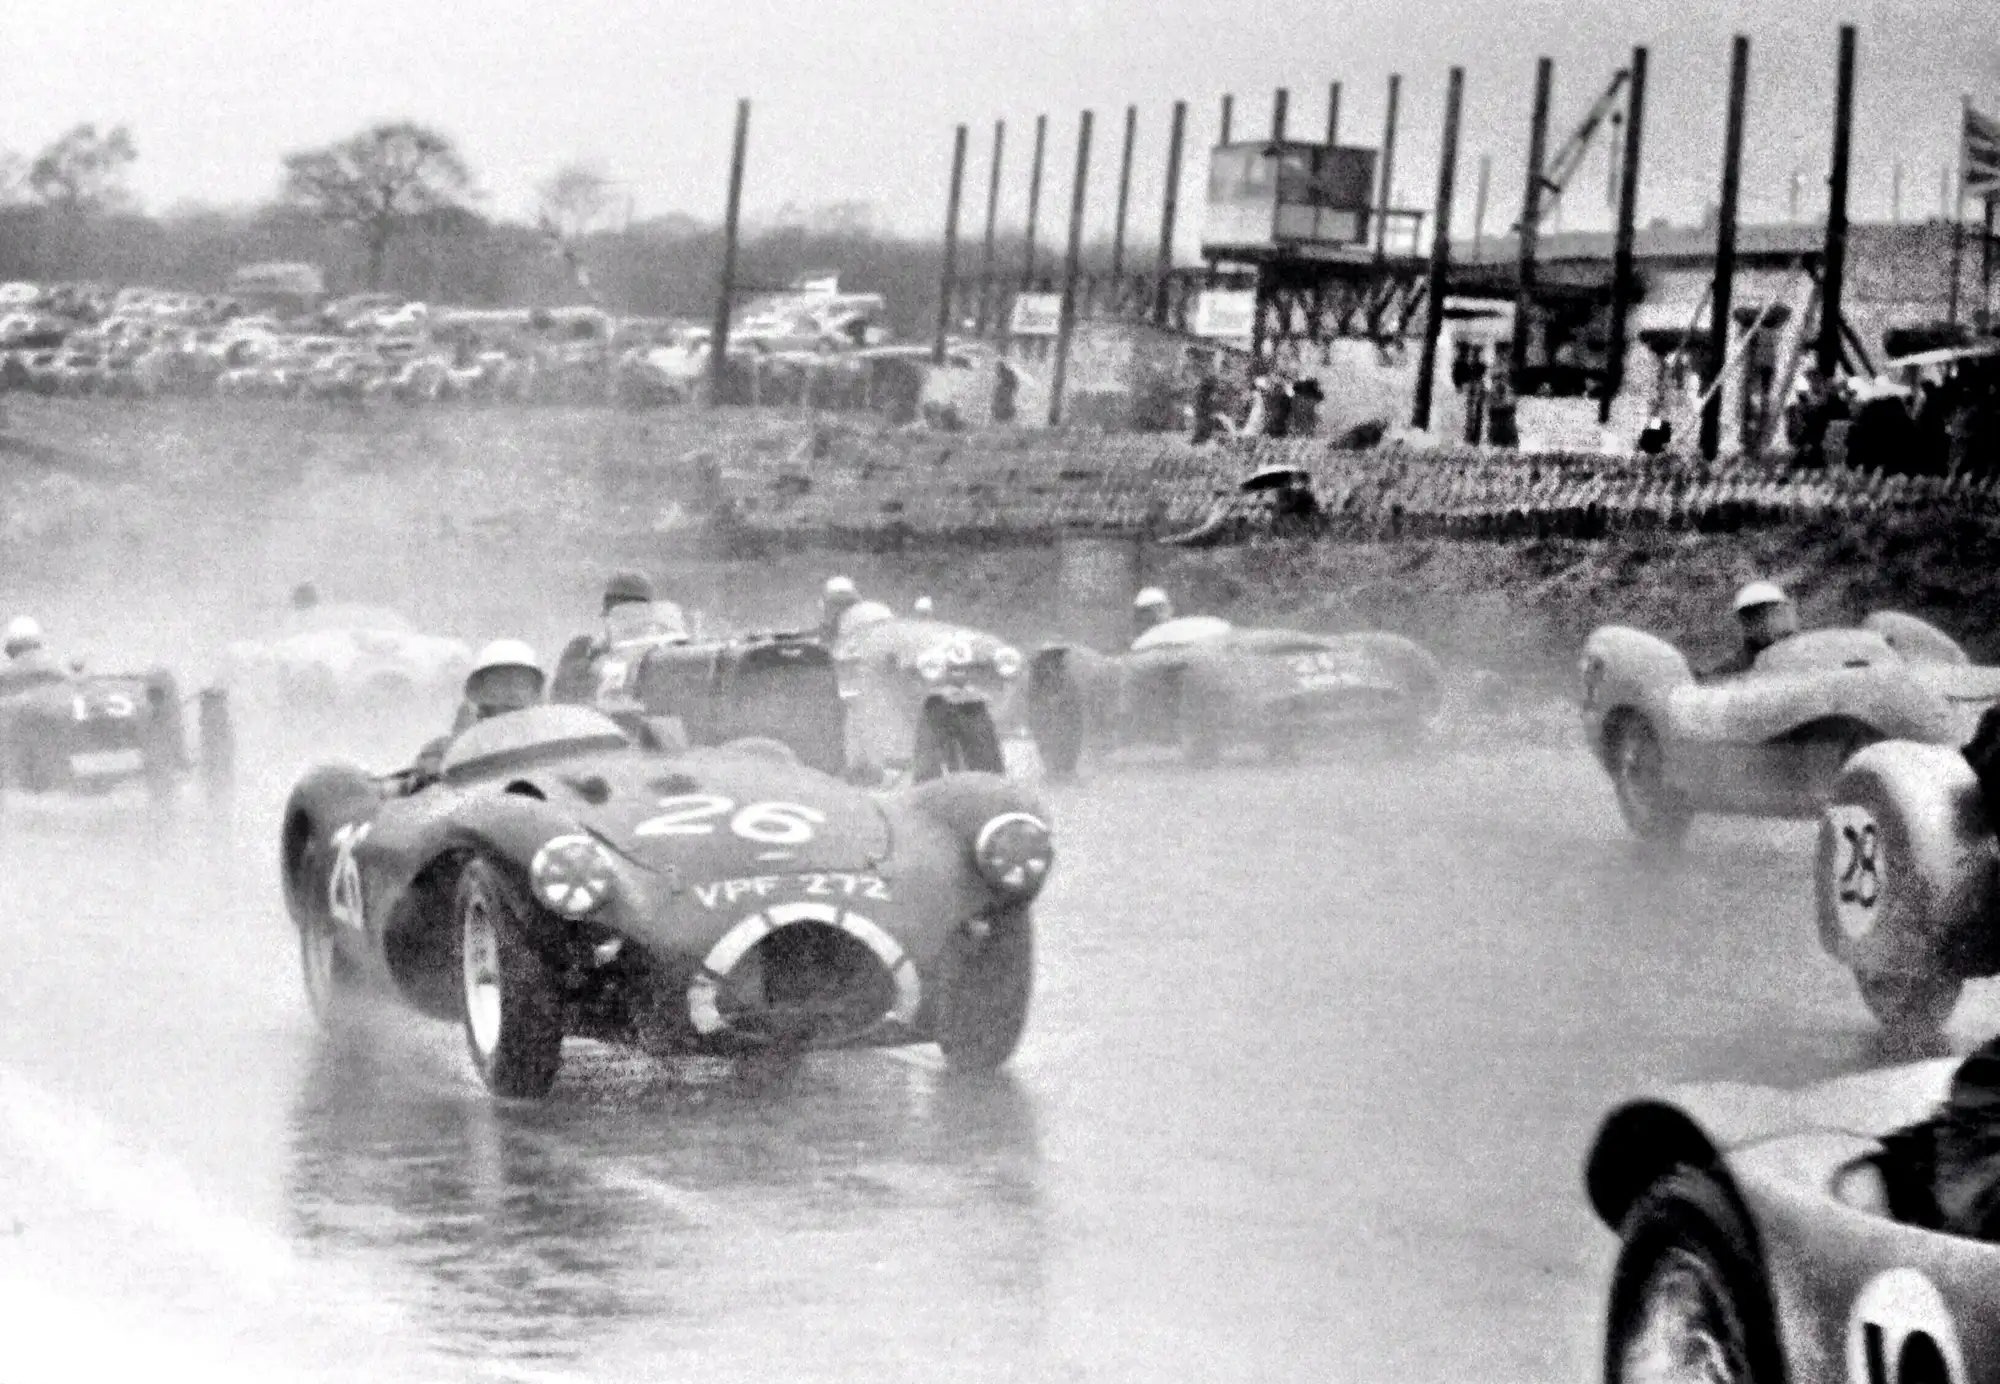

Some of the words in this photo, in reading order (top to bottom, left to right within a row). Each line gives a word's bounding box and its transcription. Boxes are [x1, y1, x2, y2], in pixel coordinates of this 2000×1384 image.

[634, 794, 826, 844] 26
[693, 876, 779, 909] VPF
[800, 872, 890, 901] 272
